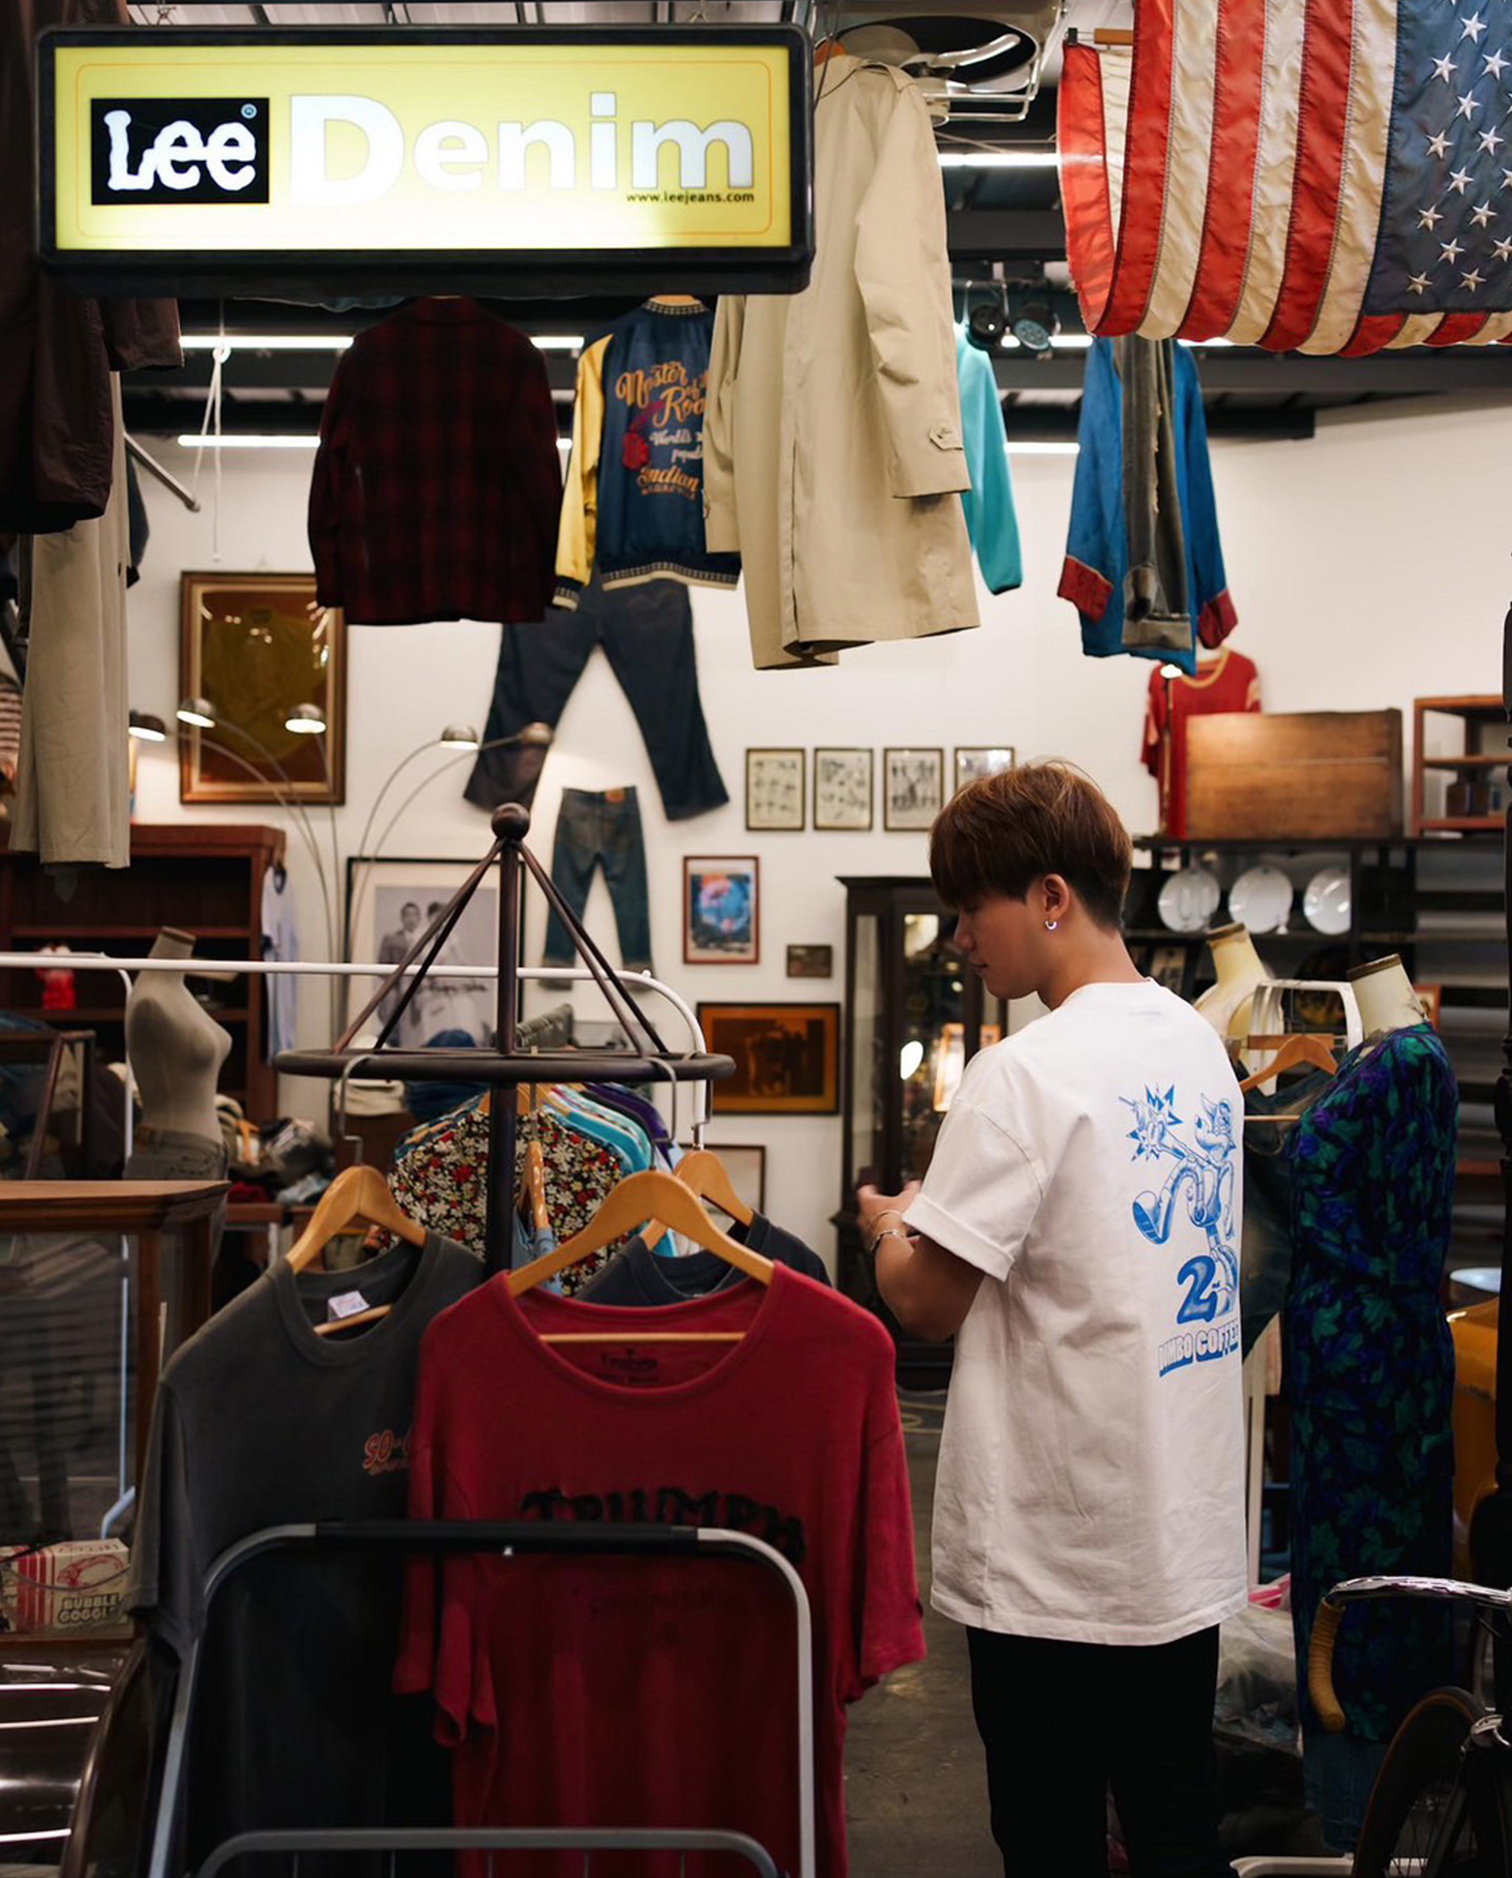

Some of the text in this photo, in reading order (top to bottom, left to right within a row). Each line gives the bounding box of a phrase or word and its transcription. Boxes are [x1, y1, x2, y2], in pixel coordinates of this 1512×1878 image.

[289, 92, 754, 199] Denim
[626, 191, 755, 205] www.leejeans.com
[62, 1592, 120, 1612] BUBBLE
